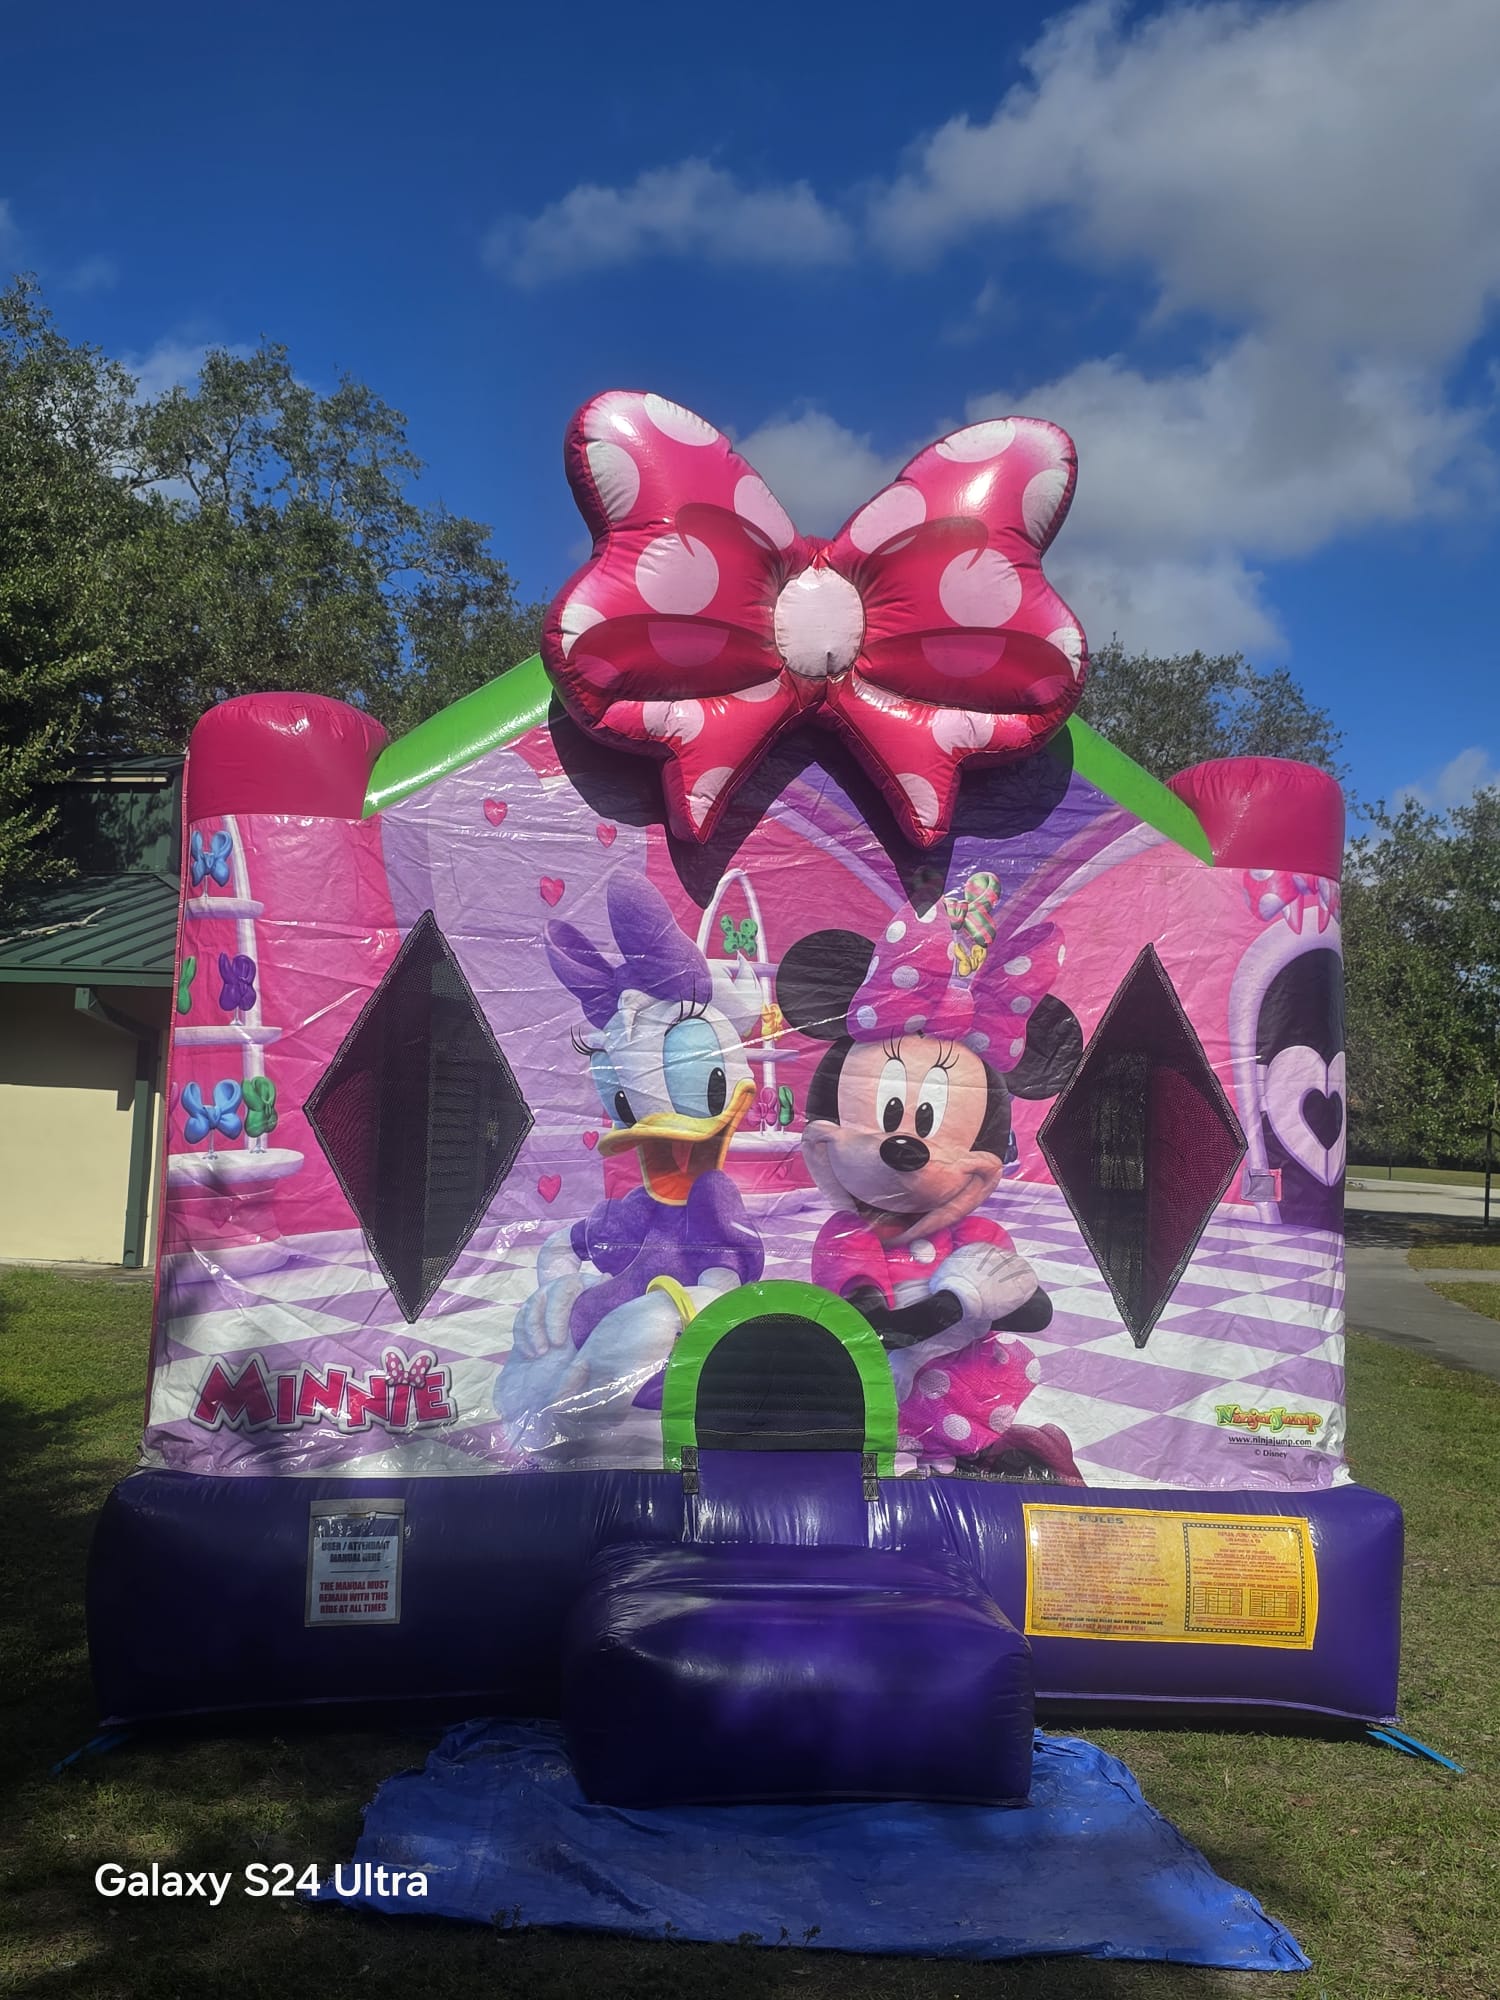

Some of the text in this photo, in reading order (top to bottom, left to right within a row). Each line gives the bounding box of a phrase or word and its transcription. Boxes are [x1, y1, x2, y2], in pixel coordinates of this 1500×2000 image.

[193, 1356, 451, 1428] MINNIE
[1228, 1435, 1312, 1447] www.ninjajump.com
[1262, 1449, 1288, 1459] Disney
[1078, 1515, 1125, 1524] RULES
[320, 1580, 389, 1591] THE MANUAL MUST
[319, 1592, 389, 1602] REMAIN WITH THIS
[338, 1604, 349, 1613] AT
[349, 1604, 362, 1613] ALL
[362, 1602, 387, 1612] TIMES
